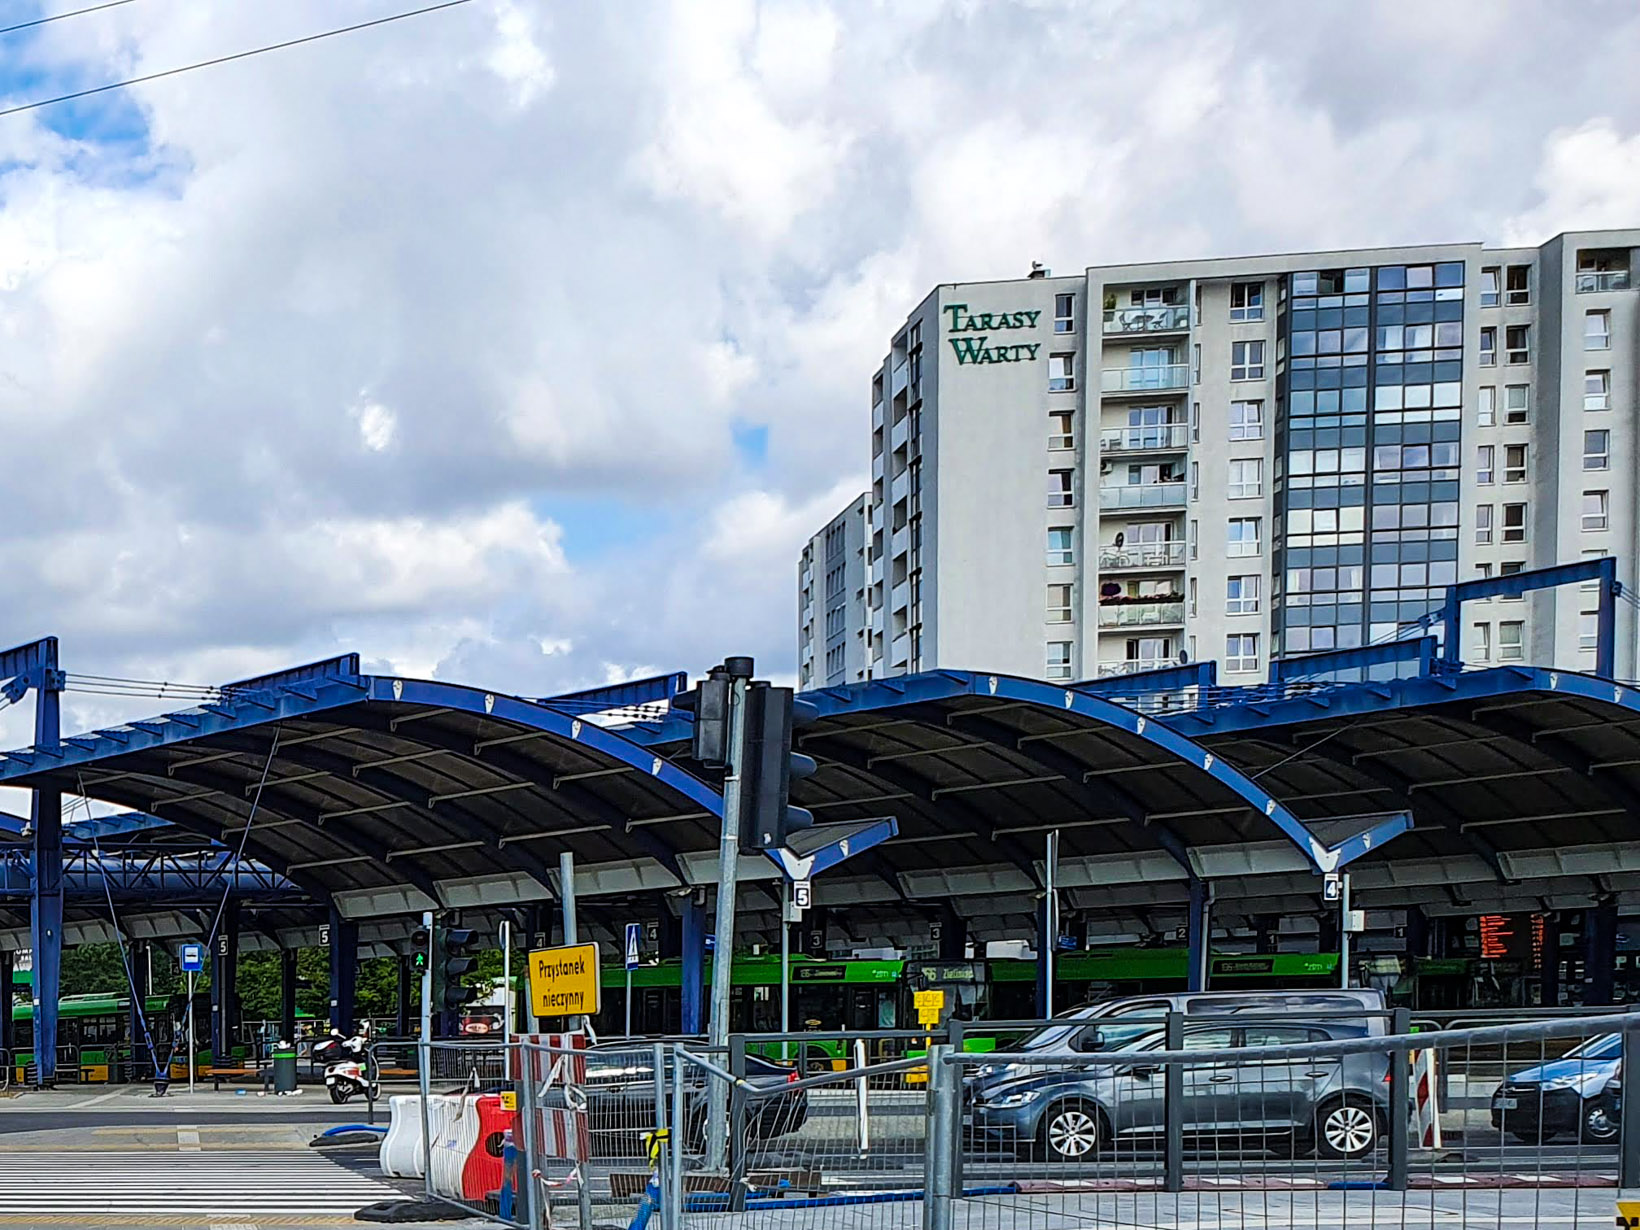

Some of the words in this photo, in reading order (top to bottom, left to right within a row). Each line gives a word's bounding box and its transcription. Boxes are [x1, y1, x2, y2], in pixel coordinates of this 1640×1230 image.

[943, 303, 1042, 333] TARASY
[947, 336, 1042, 366] WARTY
[797, 889, 808, 906] 5
[1326, 882, 1336, 898] 4
[538, 955, 586, 983] Przystanek
[542, 989, 585, 1011] nieczynny
